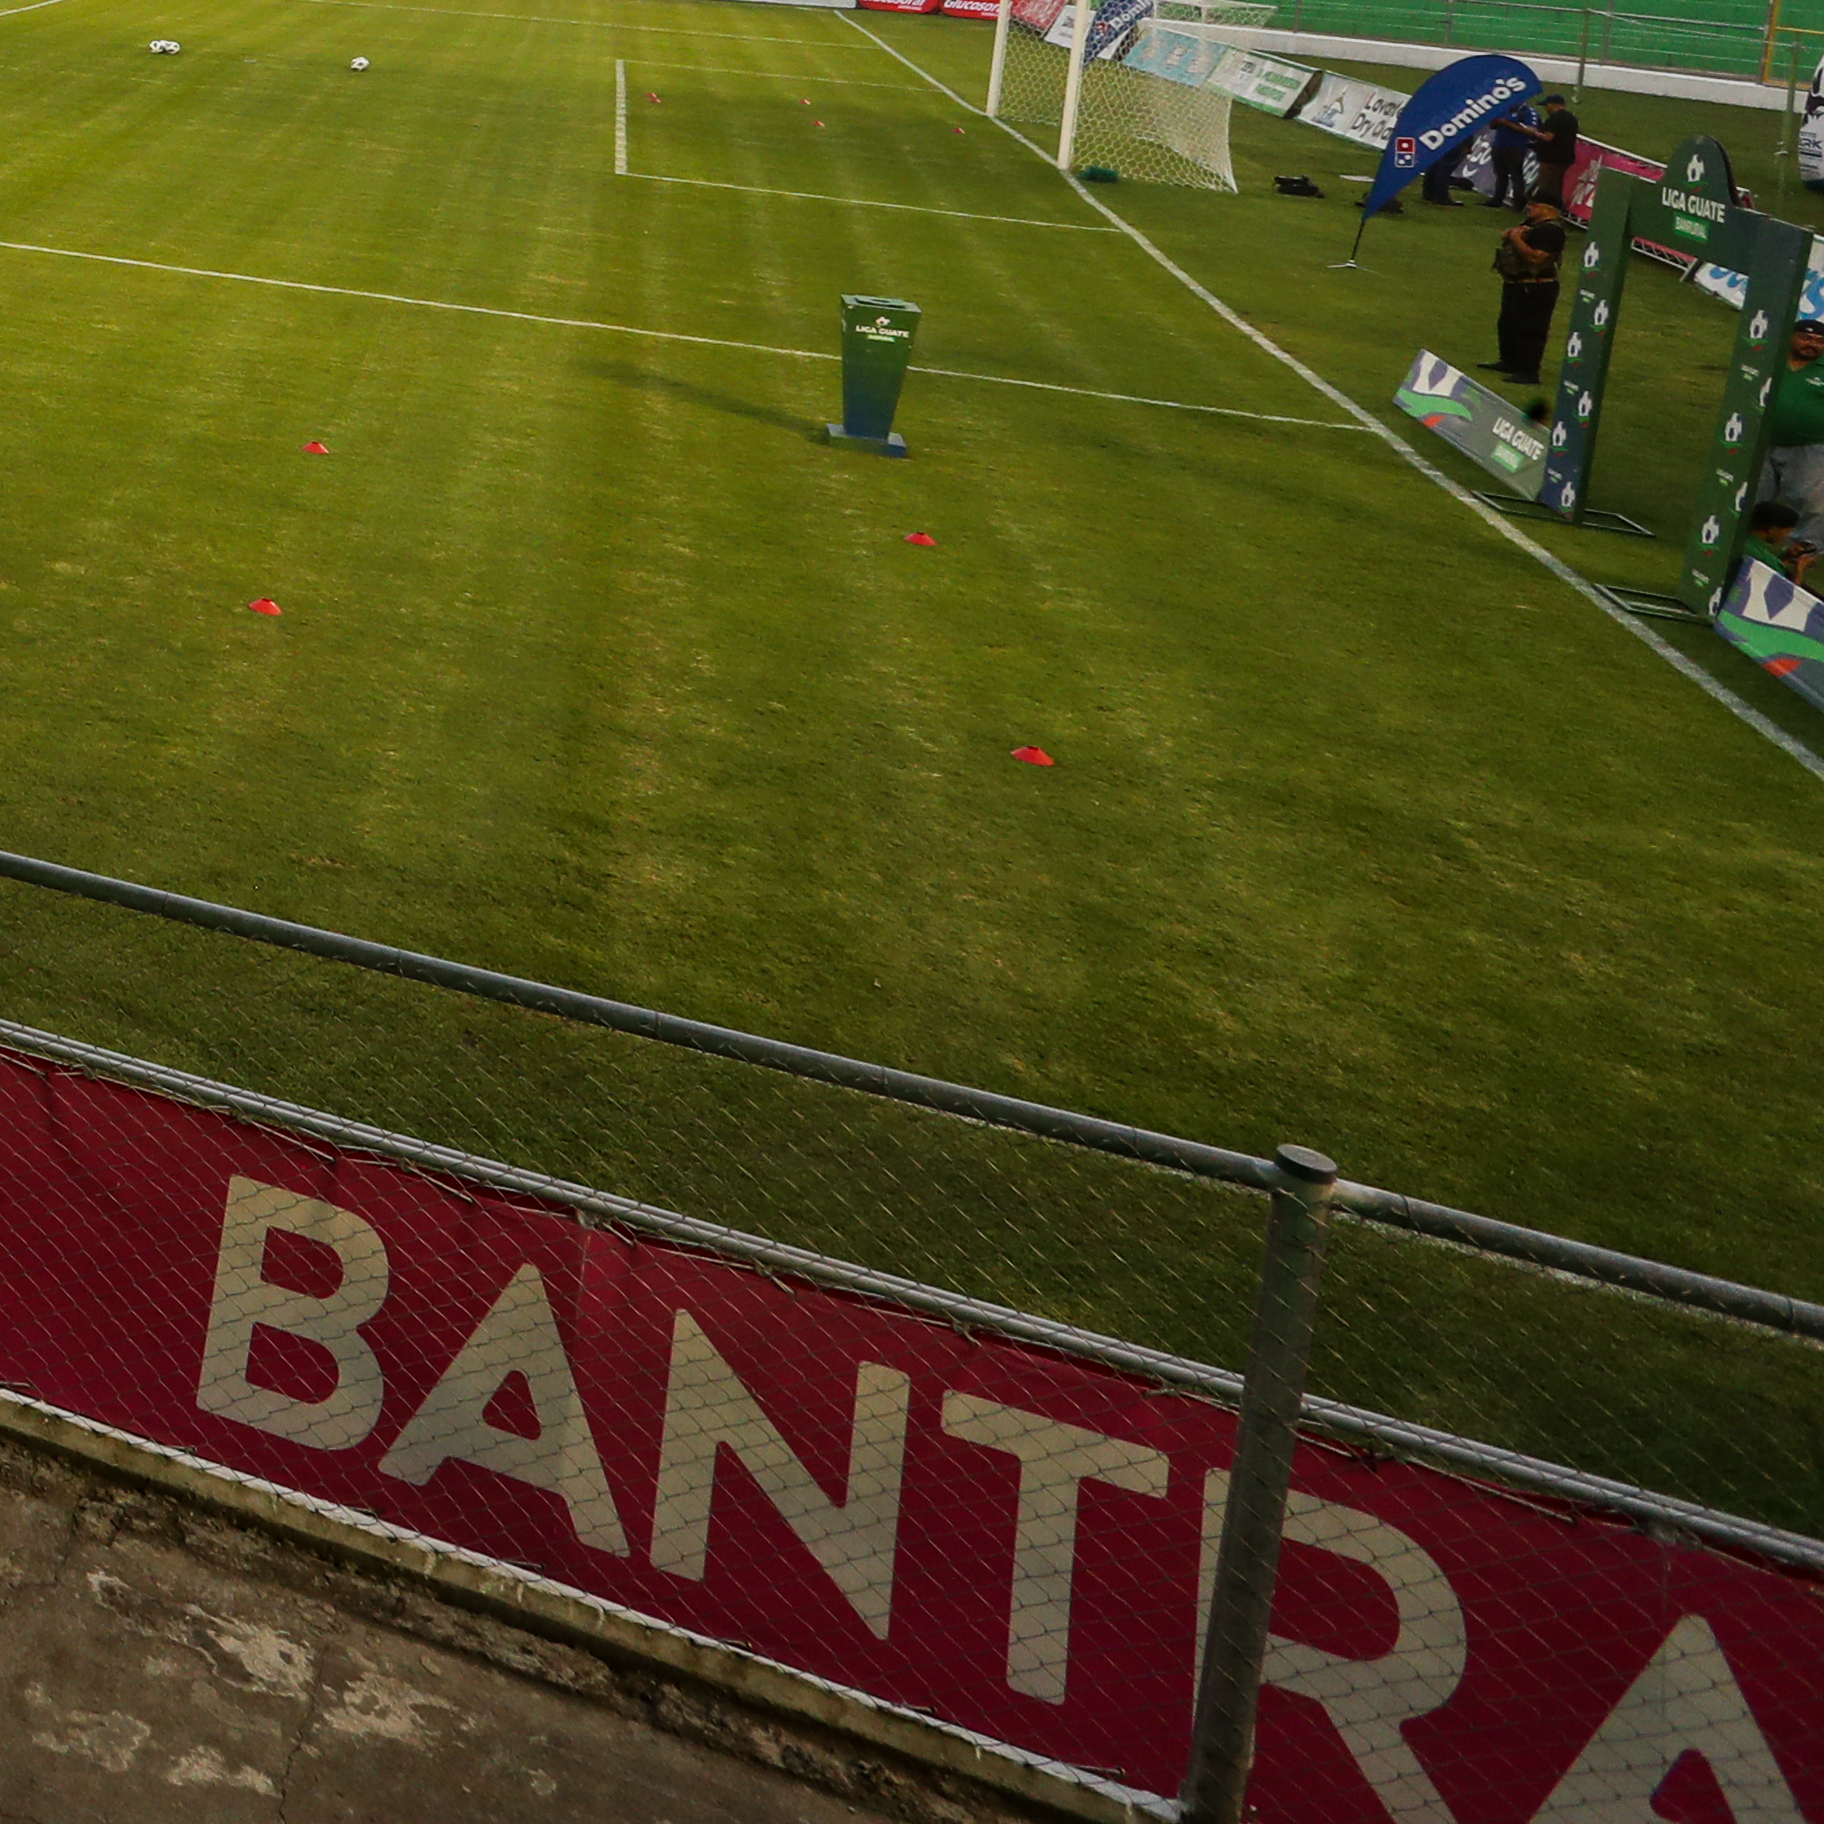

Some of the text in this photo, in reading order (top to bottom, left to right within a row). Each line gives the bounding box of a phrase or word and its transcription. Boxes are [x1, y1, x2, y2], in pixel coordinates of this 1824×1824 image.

[1418, 76, 1527, 151] Domino's
[1662, 186, 1726, 224] LIGA GUATE
[855, 325, 877, 335] LIGA
[1491, 416, 1517, 444] LIGA
